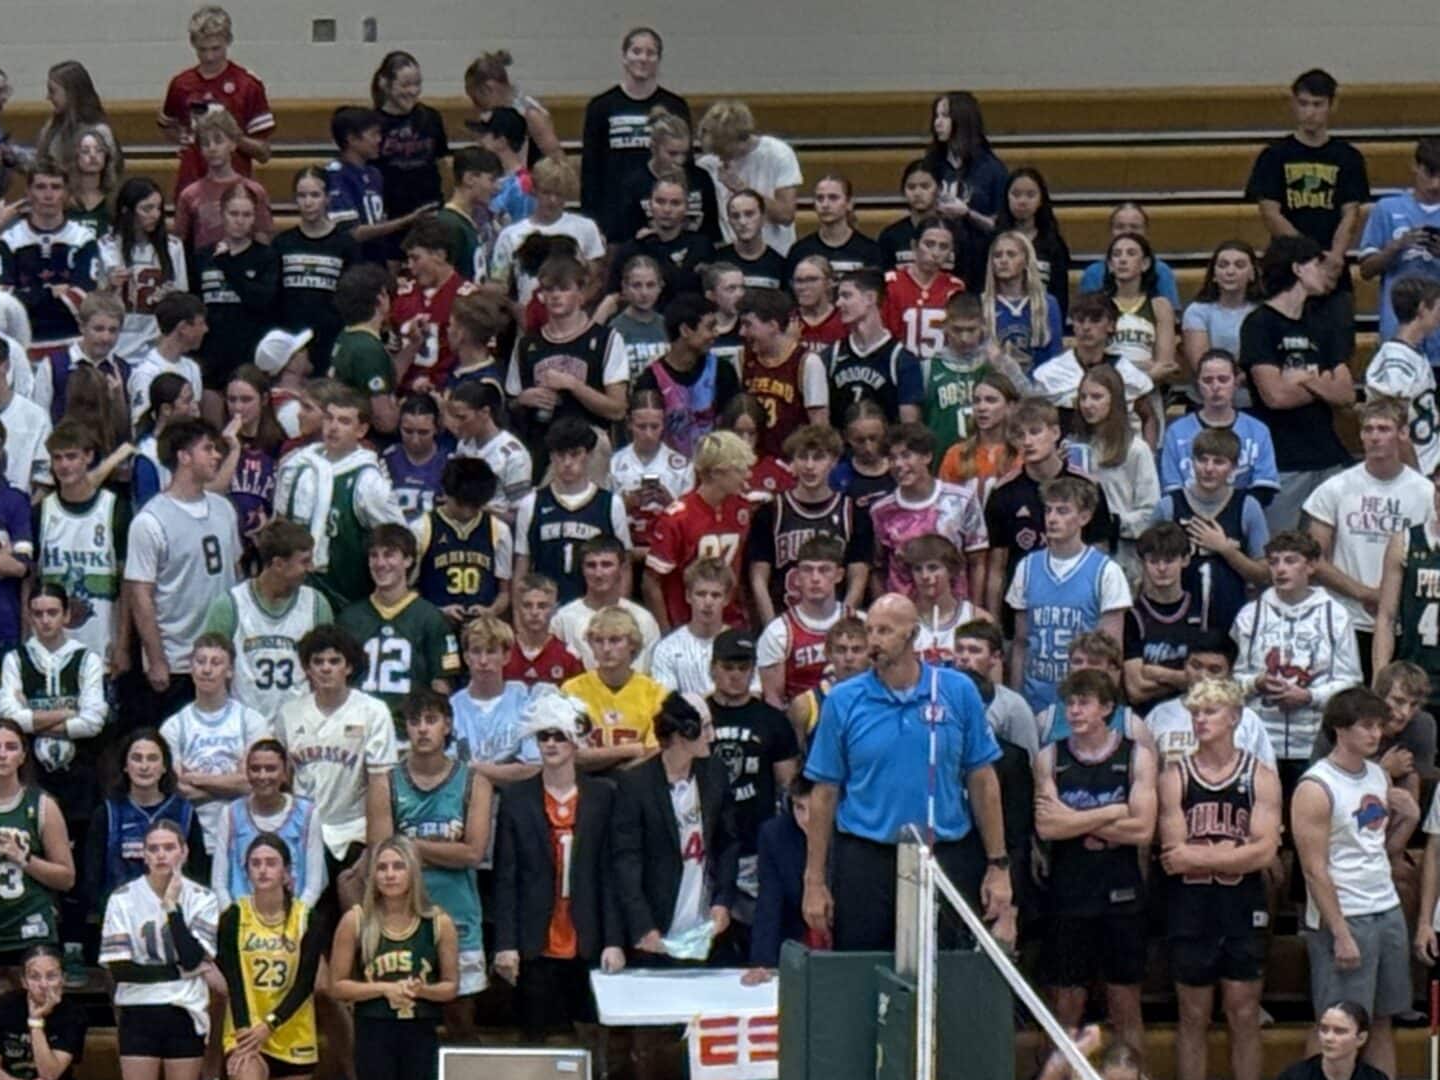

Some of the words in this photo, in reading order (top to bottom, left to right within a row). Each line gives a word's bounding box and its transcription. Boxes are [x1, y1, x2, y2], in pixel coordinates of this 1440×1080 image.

[902, 305, 947, 358] 15
[835, 364, 887, 390] BROOKLYN
[938, 382, 974, 409] BOST
[1360, 496, 1401, 516] HEAL
[94, 523, 106, 547] 8
[1345, 512, 1412, 534] CANCER
[202, 534, 224, 576] 8
[564, 542, 574, 574] 1
[446, 566, 482, 596] 30
[1033, 606, 1084, 628] NORTH
[254, 657, 295, 690] 33
[362, 636, 413, 694] 12
[242, 934, 298, 954] LAKERS
[253, 958, 288, 988] 23
